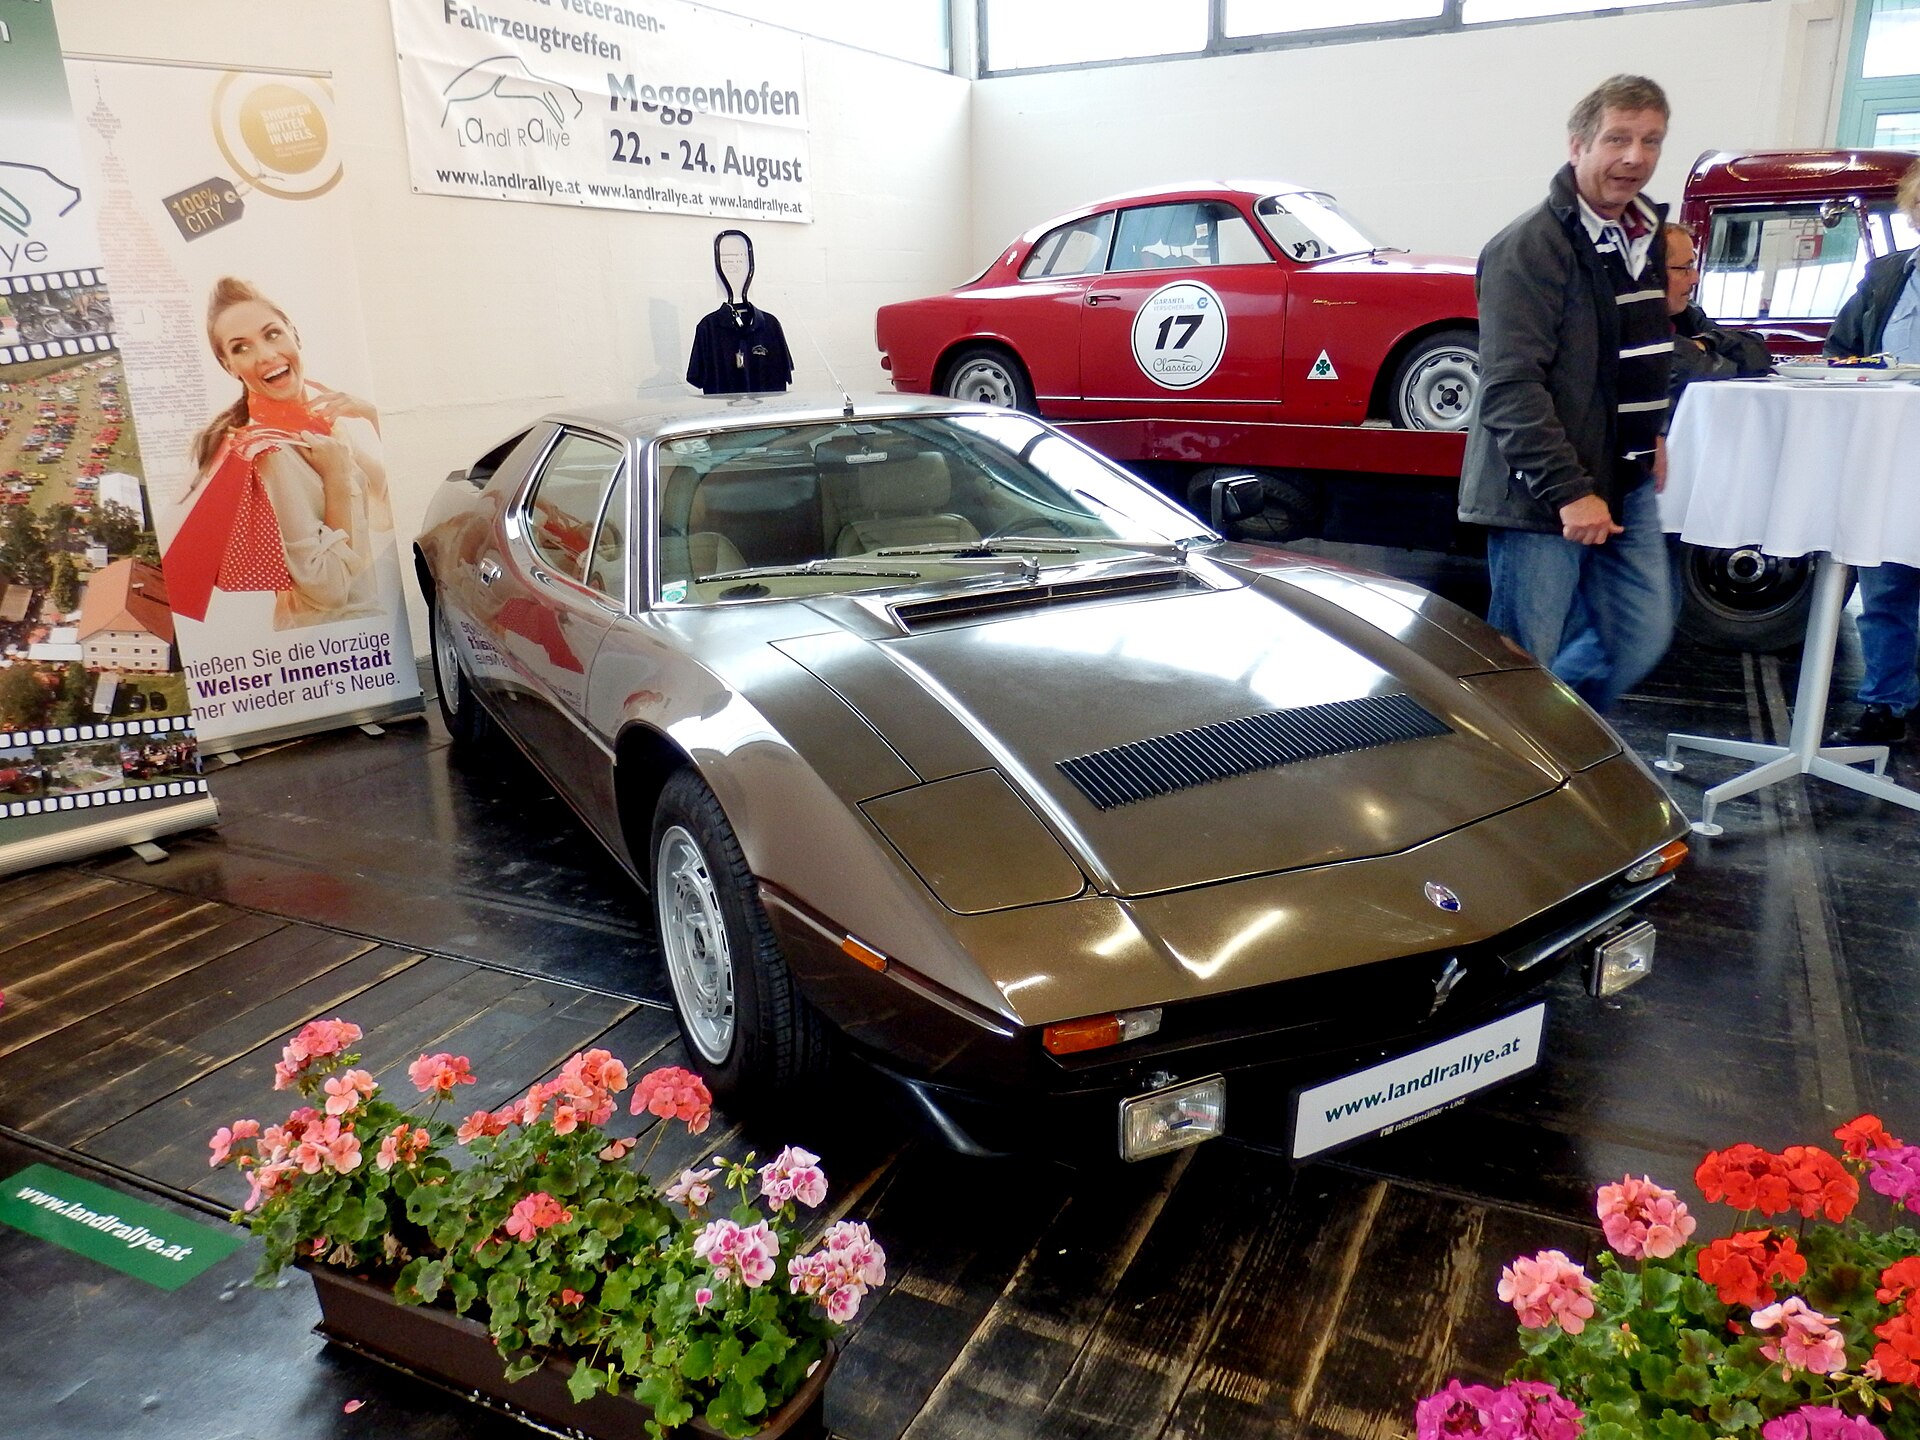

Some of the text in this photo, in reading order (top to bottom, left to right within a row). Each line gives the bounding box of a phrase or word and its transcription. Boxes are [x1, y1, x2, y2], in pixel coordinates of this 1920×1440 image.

[444, 0, 621, 61] Fahrzeugtreffen
[607, 73, 800, 125] Meggenhofen
[265, 116, 306, 134] MITTEN
[610, 129, 651, 166] 22.
[679, 140, 716, 173] 24.
[723, 145, 802, 188] August
[172, 188, 220, 217] 100%
[436, 170, 803, 215] www.landlrallye.at www.landlrallye.at www.landlrallye.at
[185, 203, 225, 233] CITY
[1155, 314, 1204, 350] 17
[1153, 357, 1200, 373] Classica
[252, 648, 283, 668] Sie
[288, 643, 316, 661] die
[319, 632, 391, 653] Vorzüge
[197, 649, 392, 699] Welser Innenstadt
[232, 689, 296, 714] wieder
[350, 672, 401, 692] Neue.
[1325, 1035, 1521, 1123] www.landlrallye.at
[15, 1186, 193, 1262] www.landlrallye.at
